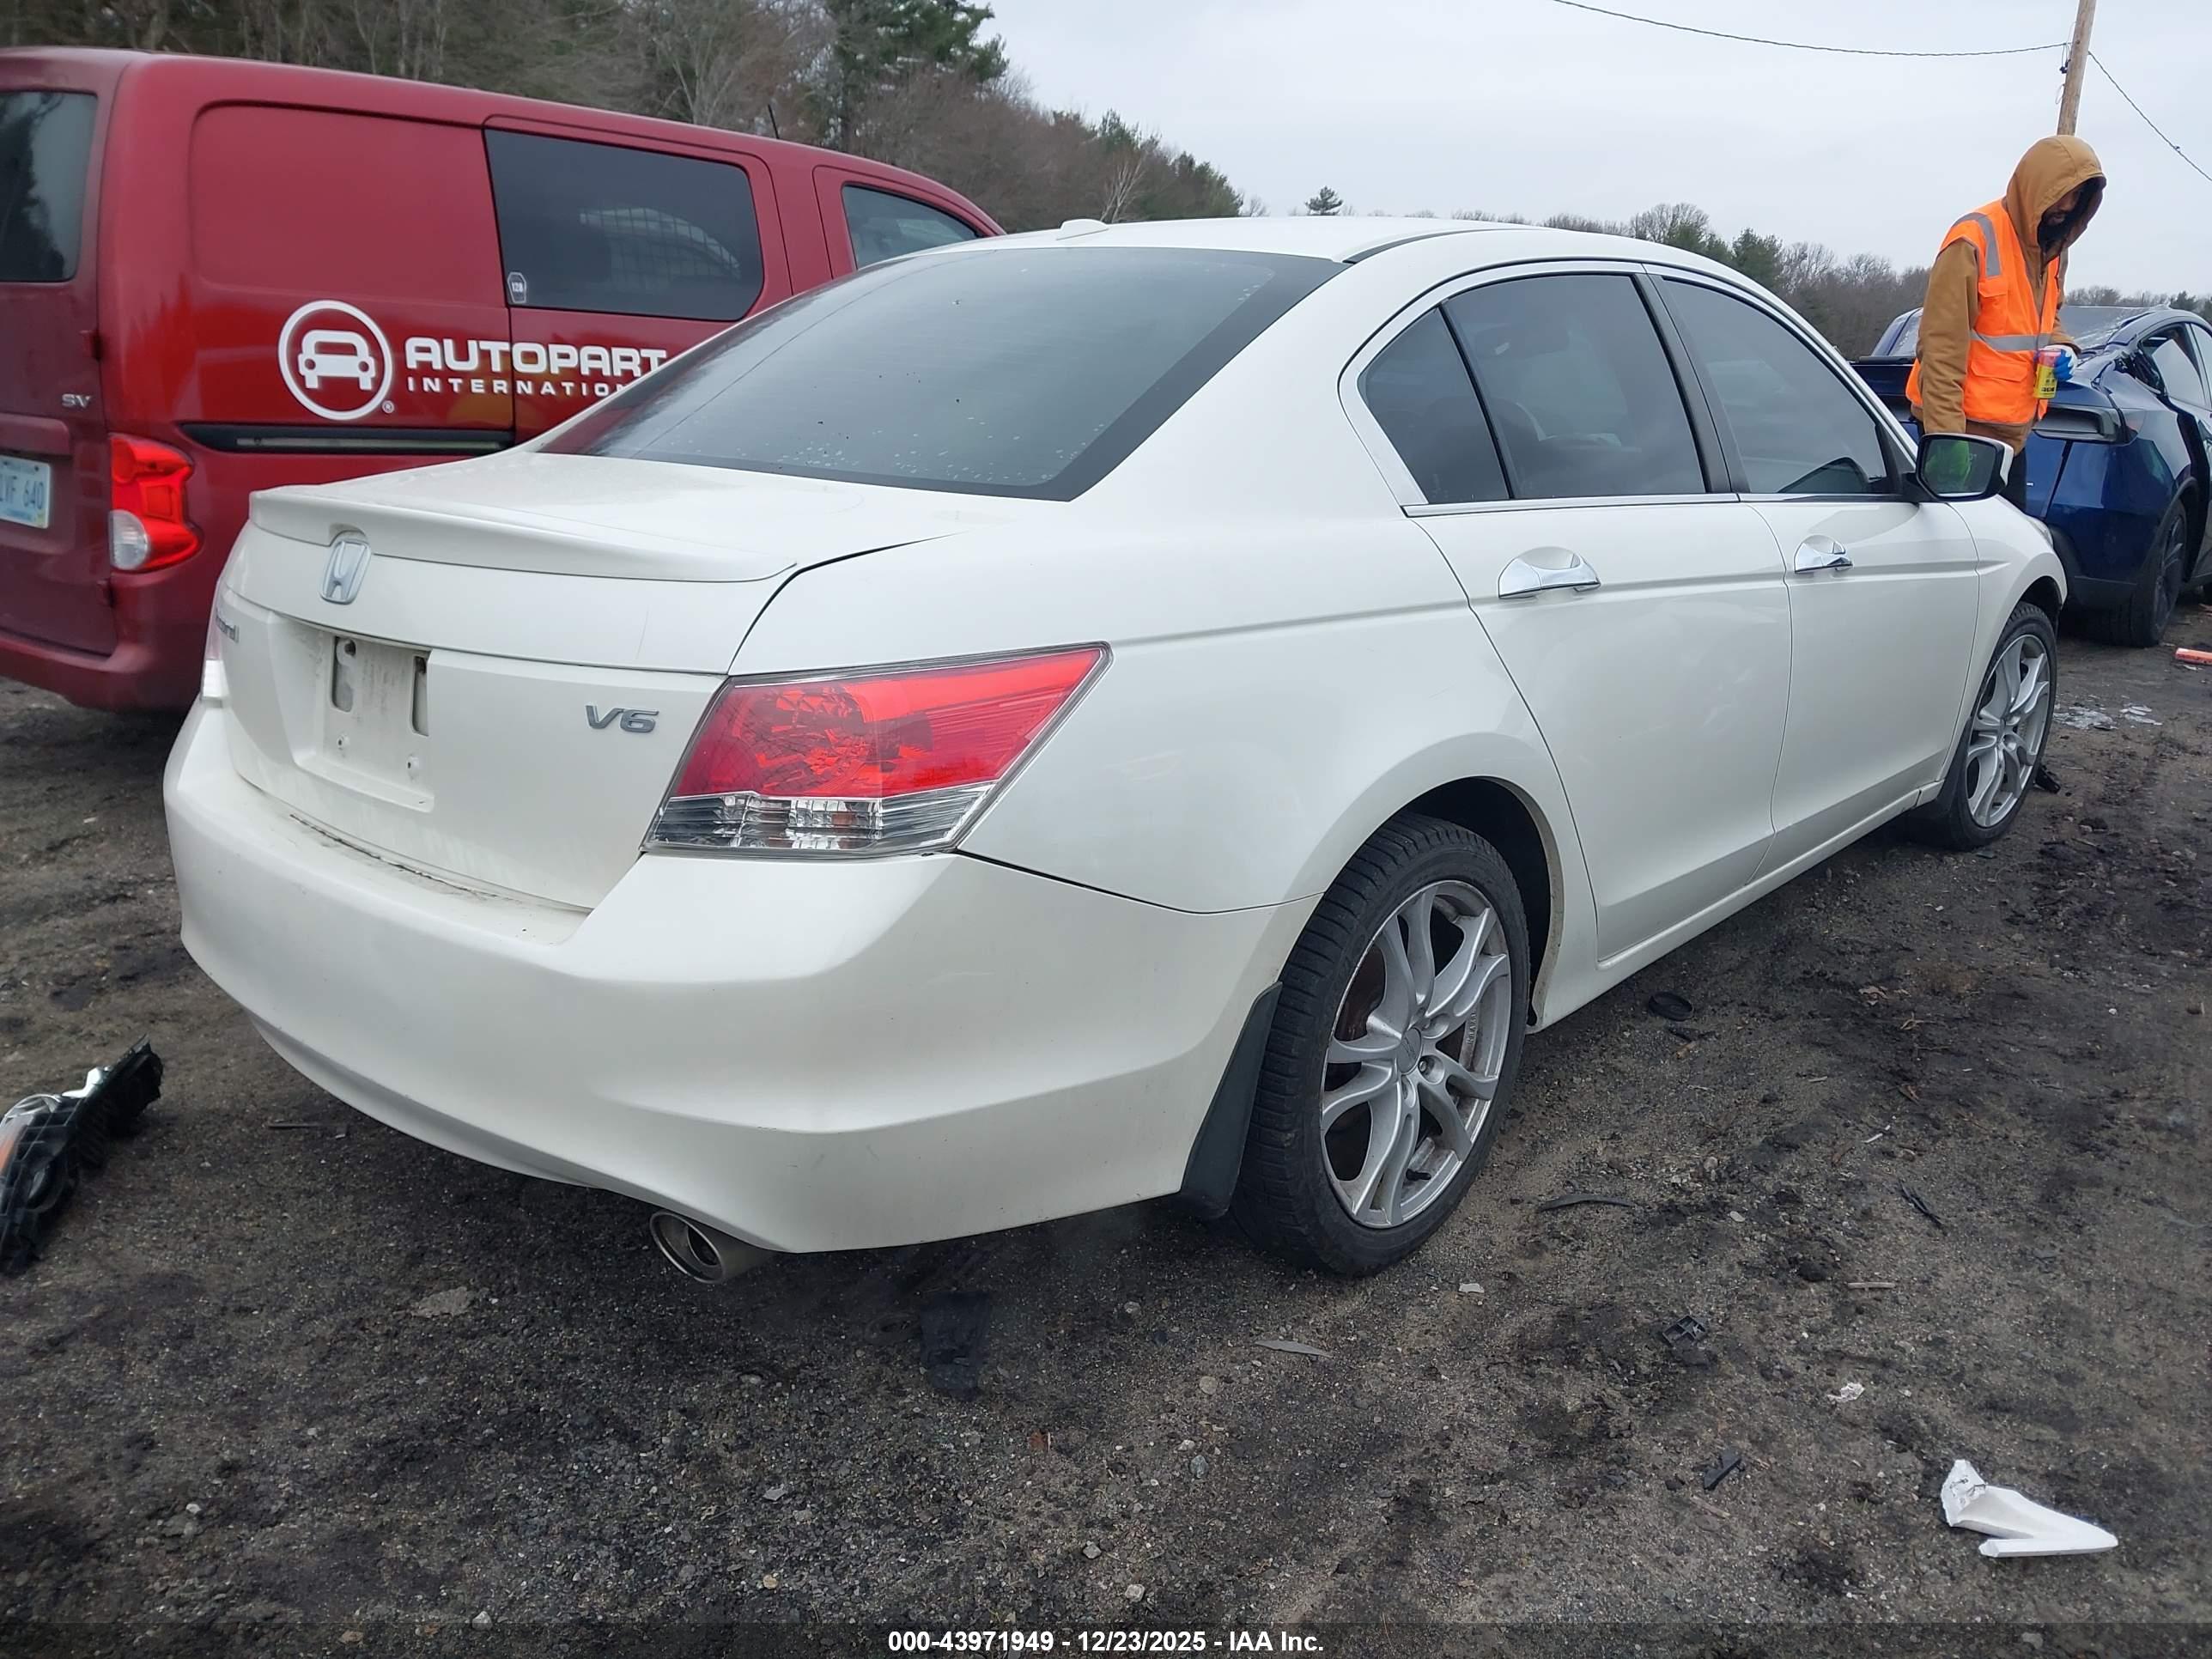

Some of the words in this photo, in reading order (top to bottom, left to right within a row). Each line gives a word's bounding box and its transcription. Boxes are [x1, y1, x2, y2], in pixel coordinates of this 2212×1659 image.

[404, 337, 667, 378] AUTOPART
[62, 393, 92, 408] SV
[585, 704, 659, 733] V6
